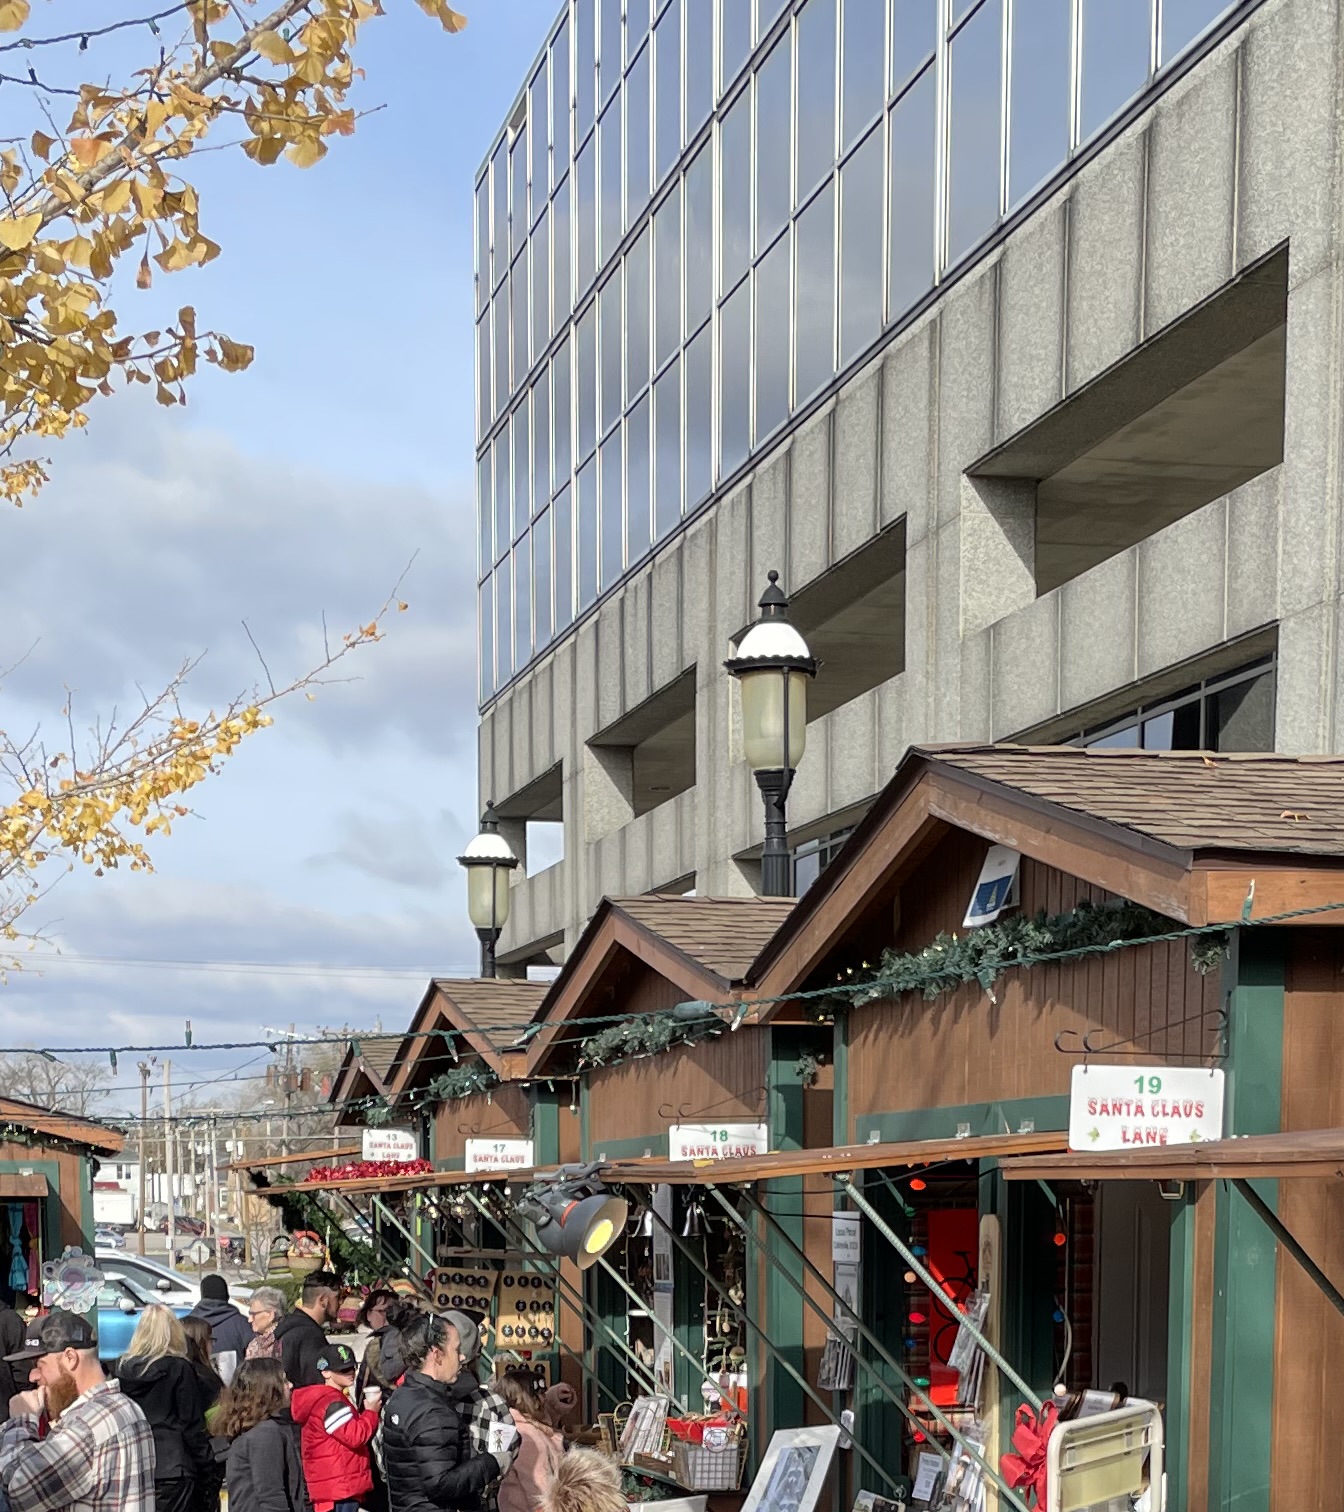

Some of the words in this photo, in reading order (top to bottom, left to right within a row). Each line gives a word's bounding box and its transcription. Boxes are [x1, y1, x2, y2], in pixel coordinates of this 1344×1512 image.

[1133, 1075, 1163, 1095] 19
[1087, 1096, 1146, 1118] SANTA
[1150, 1099, 1205, 1119] CLAUS
[710, 1129, 729, 1142] 18
[1120, 1125, 1169, 1145] LANE
[492, 1143, 506, 1154] 17
[680, 1143, 719, 1157] SANTA
[721, 1144, 757, 1157] CLAUS
[472, 1153, 499, 1164] SANTA
[500, 1154, 525, 1165] CLAUS
